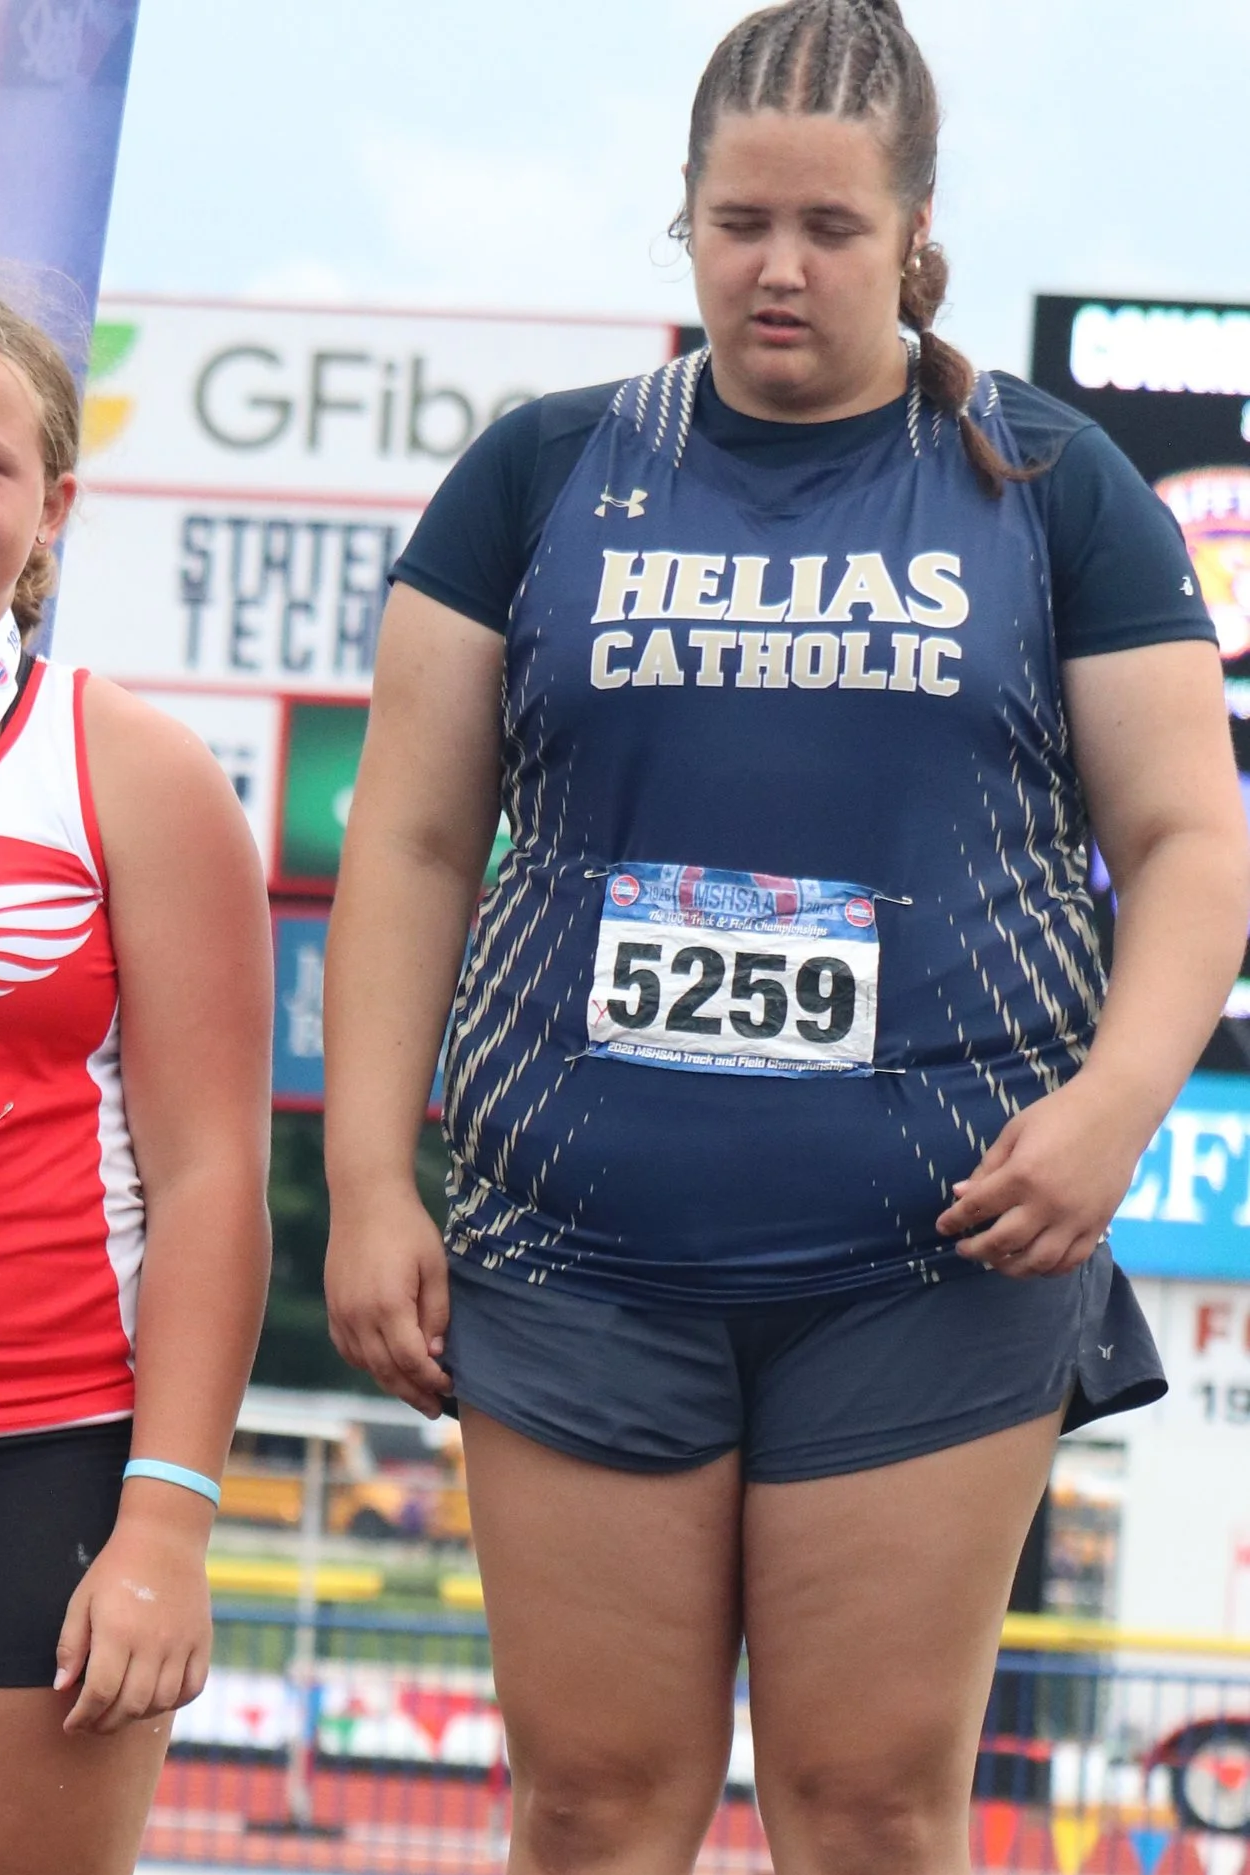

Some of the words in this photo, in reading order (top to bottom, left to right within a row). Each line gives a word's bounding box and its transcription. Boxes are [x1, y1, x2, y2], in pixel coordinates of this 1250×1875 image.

[195, 344, 538, 459] GFib
[591, 549, 970, 629] HELIAS
[591, 628, 963, 698] CATHOLIC
[691, 914, 715, 928] Track
[716, 917, 728, 929] &
[729, 917, 752, 931] Field
[755, 920, 828, 938] Championships
[694, 883, 775, 916] MSHSAA
[606, 941, 856, 1044] 5259
[608, 1042, 635, 1055] 2026
[635, 1045, 682, 1063] MSHSAA
[683, 1052, 713, 1066] Track
[715, 1055, 736, 1067] and
[738, 1055, 765, 1068] Field
